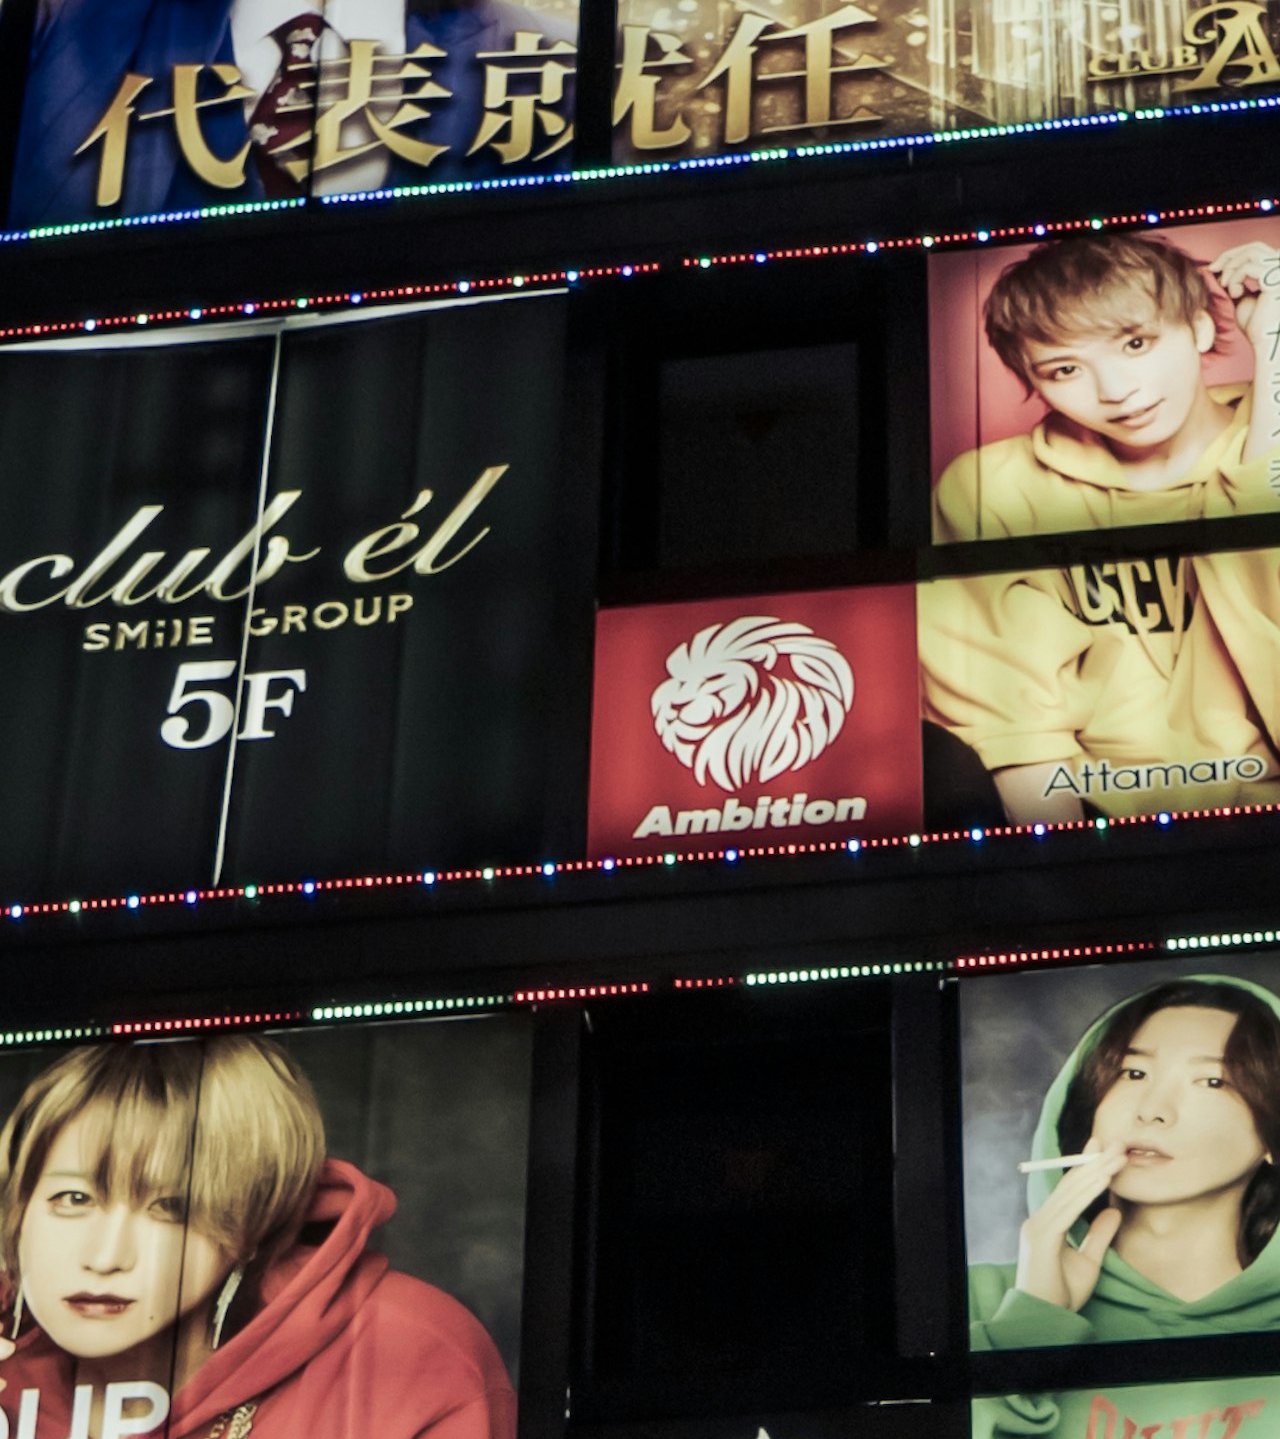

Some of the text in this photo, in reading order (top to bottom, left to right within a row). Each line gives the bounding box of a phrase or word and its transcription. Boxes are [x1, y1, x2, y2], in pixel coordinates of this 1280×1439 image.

[247, 594, 415, 638] GROUP
[160, 660, 307, 750] 5F
[1043, 753, 1265, 800] Attamaro
[632, 794, 868, 840] Ambition
